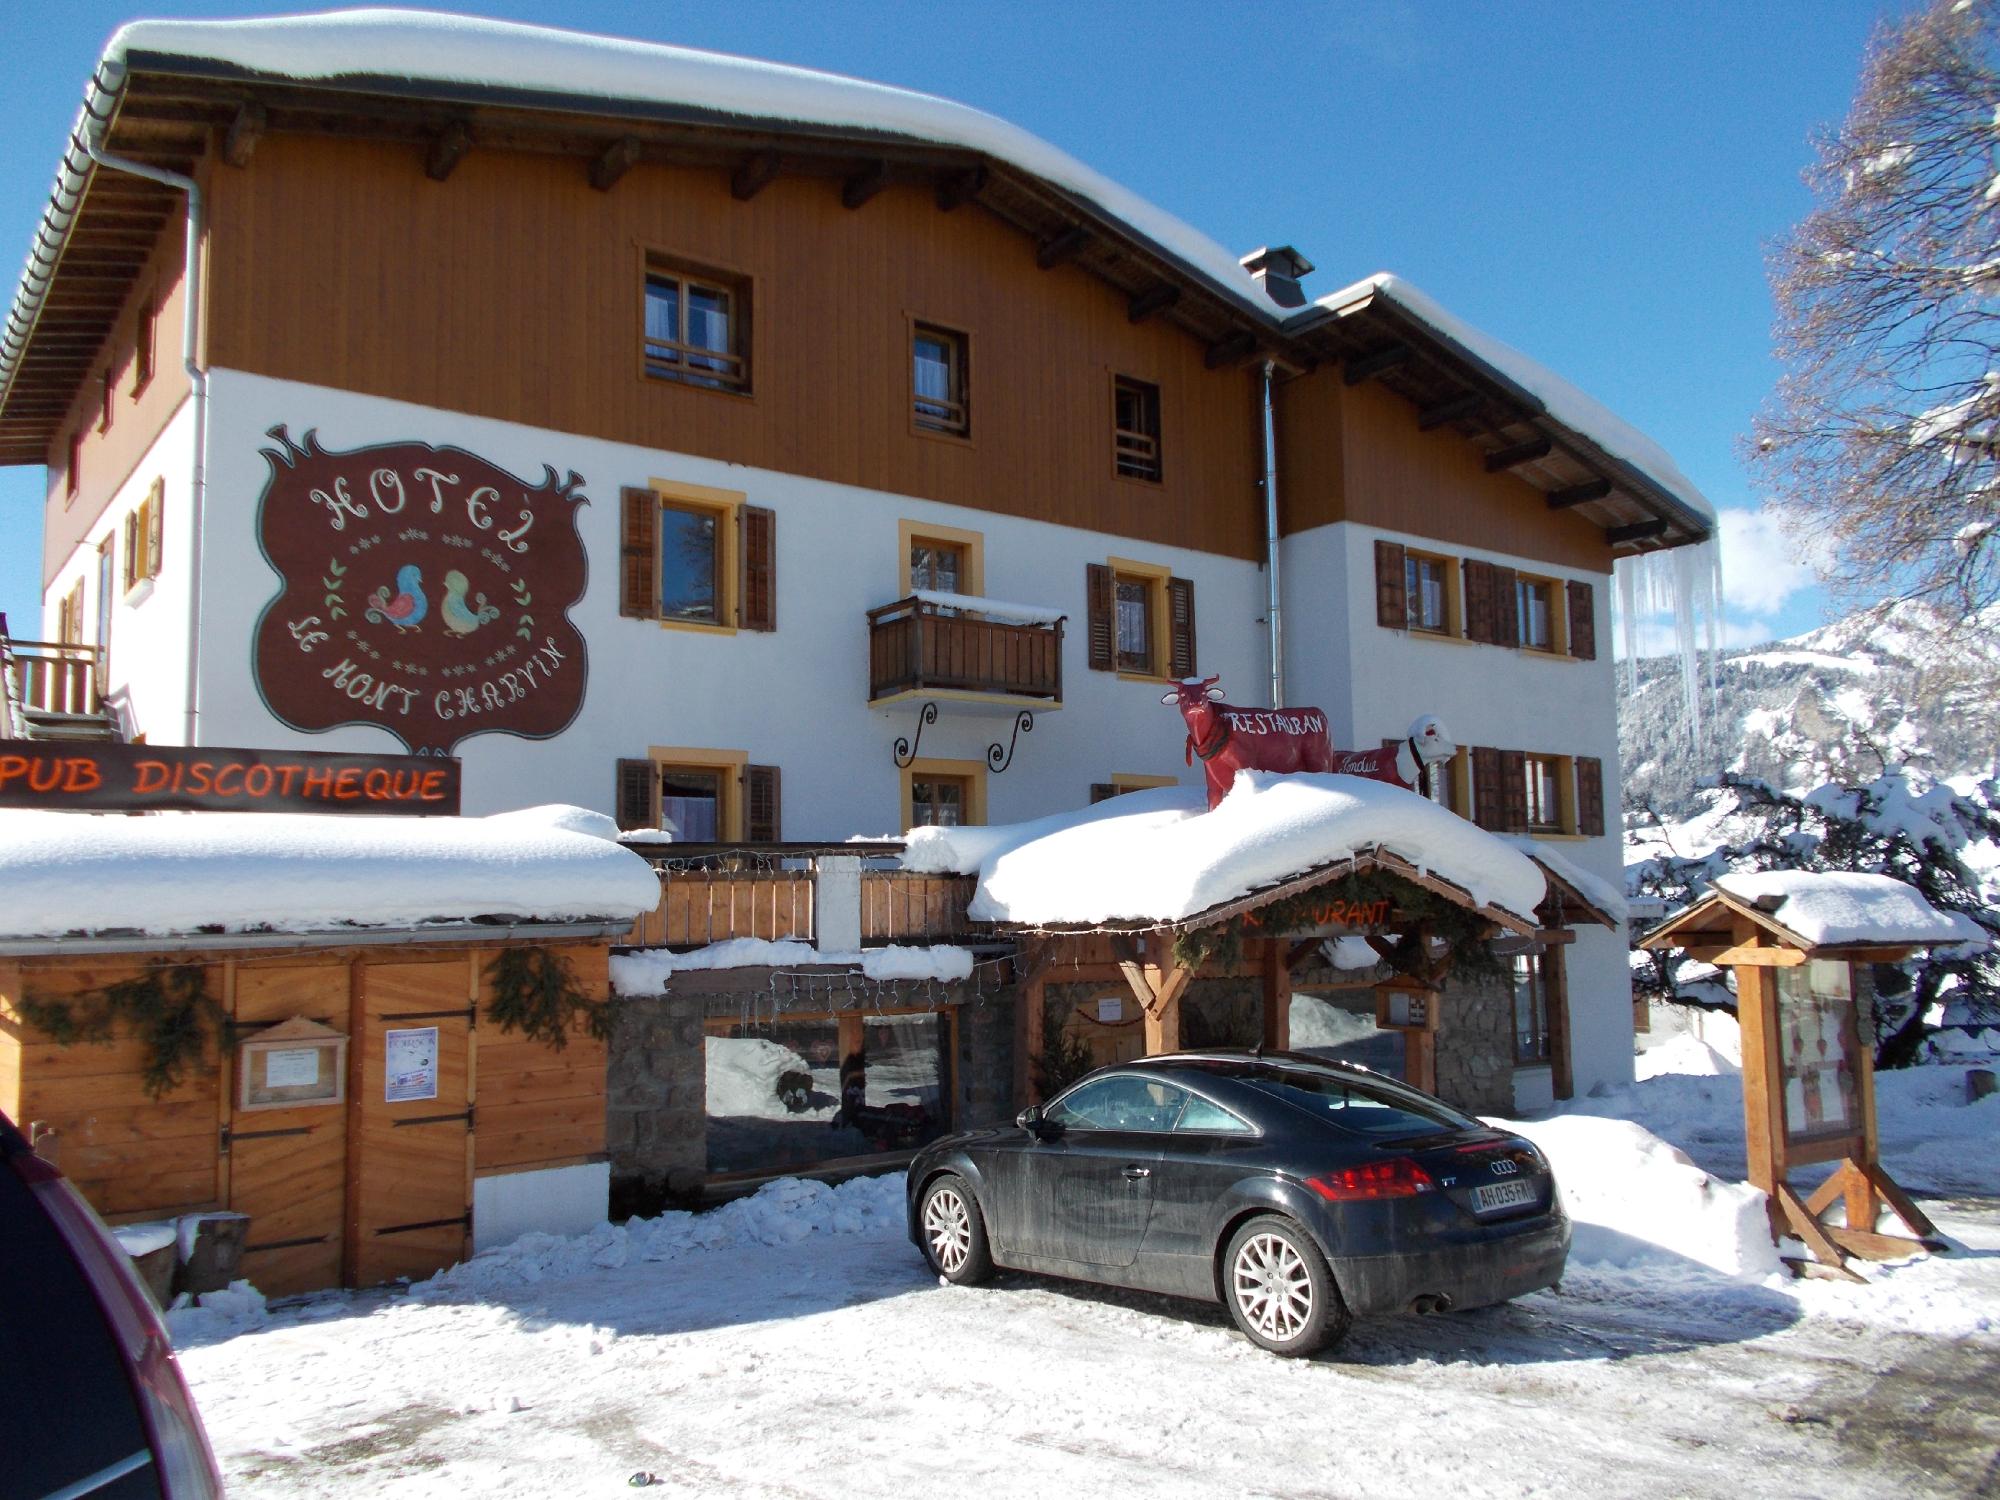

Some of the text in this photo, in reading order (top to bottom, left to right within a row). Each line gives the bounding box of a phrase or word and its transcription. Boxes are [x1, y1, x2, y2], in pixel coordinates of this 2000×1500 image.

[309, 467, 533, 553] HOTEL
[288, 616, 329, 652] LE
[322, 658, 420, 715] MONT
[0, 756, 446, 801] PUB DISCOTHEQUE
[1442, 1176, 1457, 1187] TT
